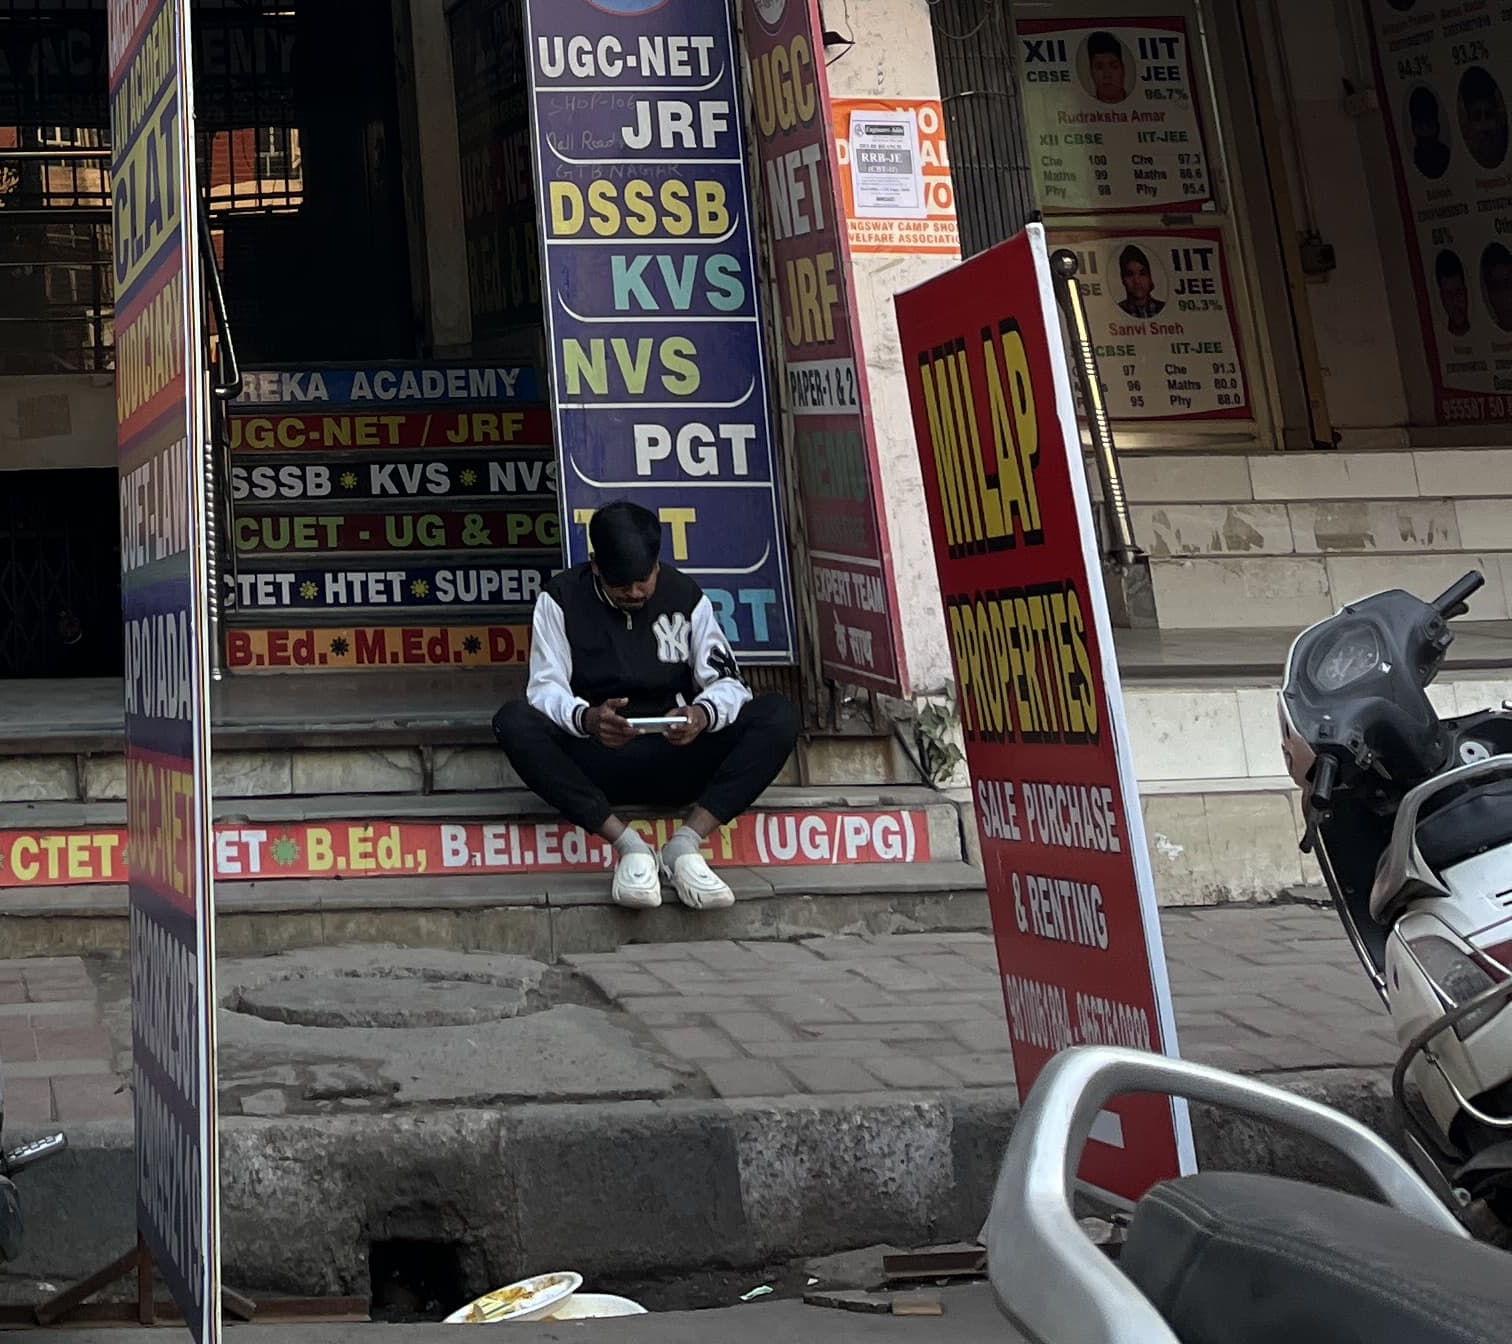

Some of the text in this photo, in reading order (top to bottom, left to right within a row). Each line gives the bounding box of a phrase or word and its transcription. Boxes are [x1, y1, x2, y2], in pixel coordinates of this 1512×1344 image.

[538, 36, 714, 78] UGC-NET
[1138, 38, 1178, 59] IIT
[1141, 66, 1181, 81] JEE
[751, 36, 816, 138] UGC
[1027, 70, 1070, 82] CBSE
[621, 101, 729, 150] JRF
[115, 89, 178, 284] CLAT
[549, 179, 730, 237] DSSSB
[766, 143, 825, 242] NET
[611, 254, 745, 312] KVS
[1172, 248, 1213, 271] IIT
[786, 251, 838, 347] JRF
[1175, 279, 1215, 294] JEE
[118, 272, 182, 424] JUDICIARY
[562, 336, 701, 395] NVS
[350, 368, 520, 401] ACADEMY
[790, 369, 833, 408] PAPER-1
[447, 413, 524, 443] JRF
[633, 424, 756, 477] PGT
[121, 439, 187, 573] CUET-LAW
[370, 464, 451, 495] KVS
[235, 516, 344, 551] CUET
[384, 515, 445, 547] UG
[324, 569, 542, 604] HTET SUPER
[125, 609, 191, 719] APO/ADA
[228, 628, 462, 666] B.Ed. M.Ed.
[947, 580, 1100, 744] PROPERTIES
[128, 759, 193, 897] UGC-NET
[755, 812, 915, 865] (UG/PG)
[977, 779, 1121, 854] SALE PURCHASE
[10, 834, 119, 878] CTET
[1026, 871, 1110, 950] RENTING
